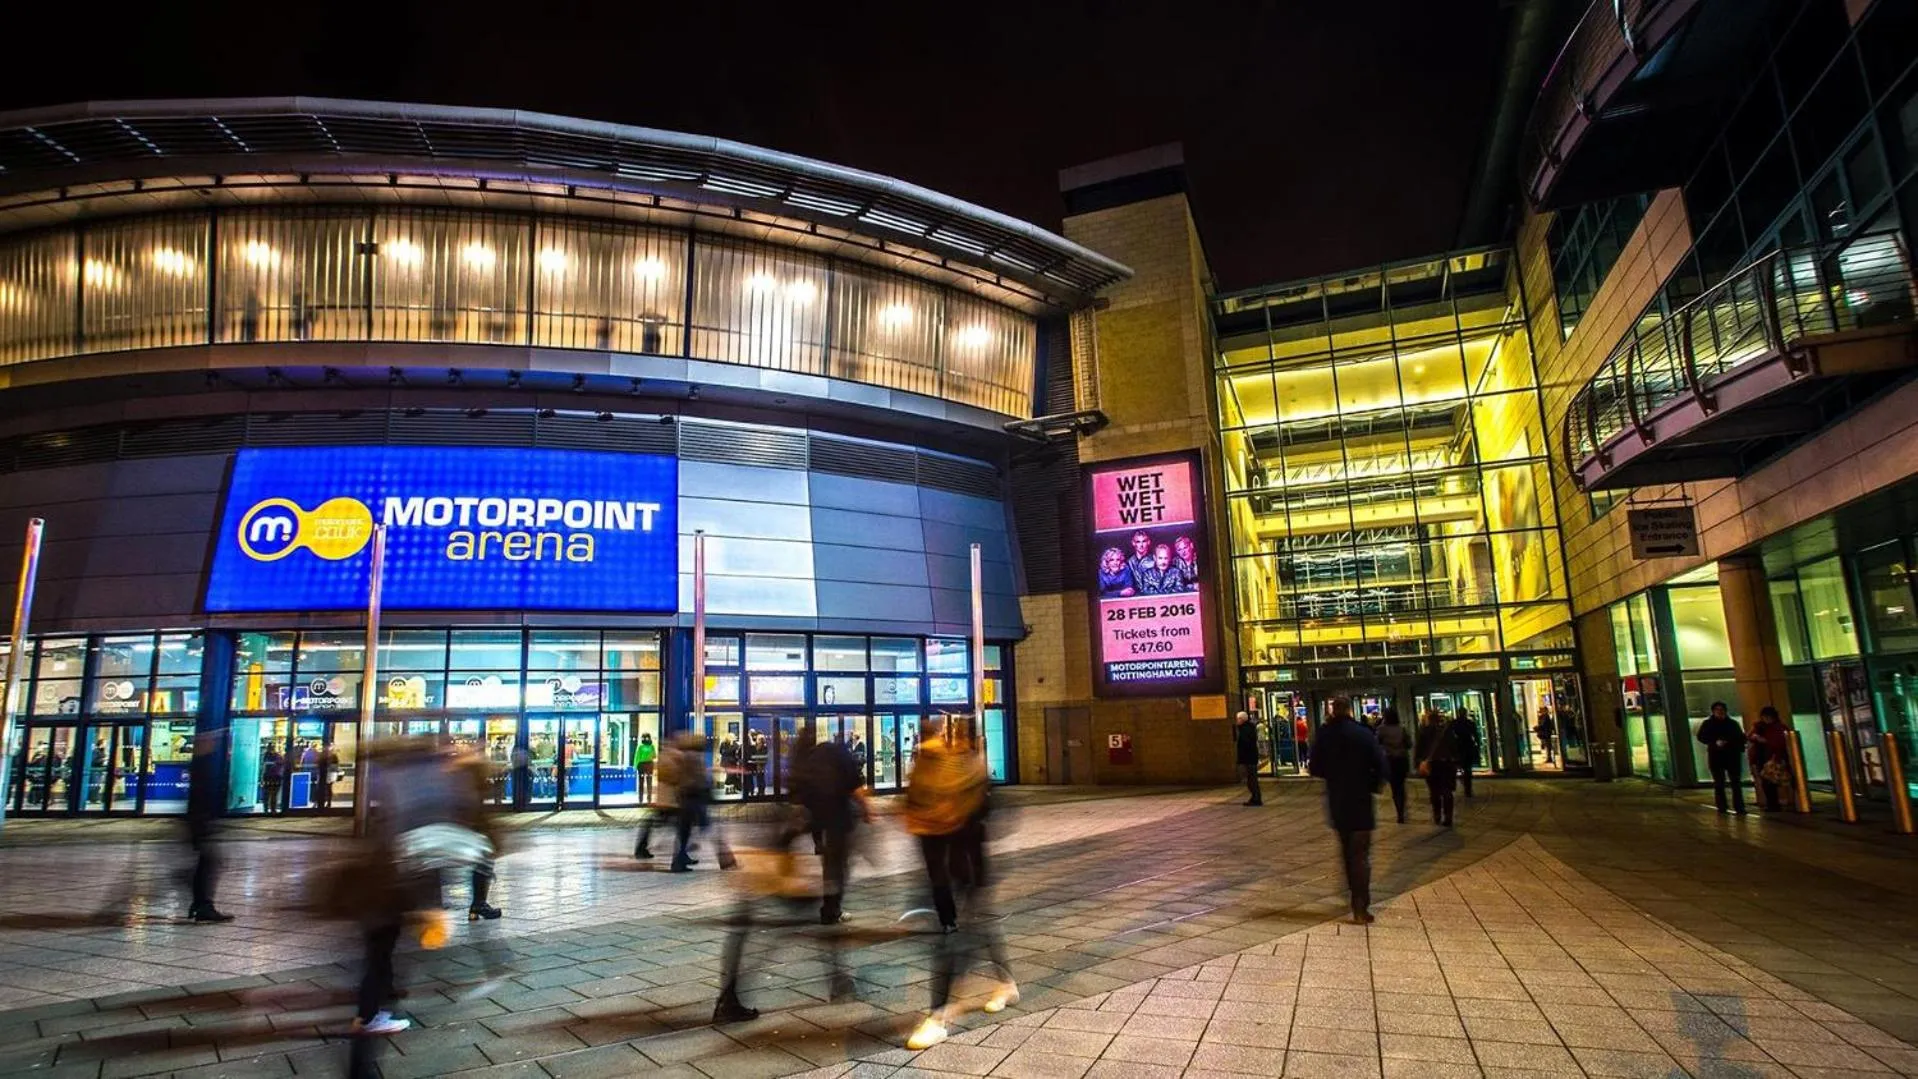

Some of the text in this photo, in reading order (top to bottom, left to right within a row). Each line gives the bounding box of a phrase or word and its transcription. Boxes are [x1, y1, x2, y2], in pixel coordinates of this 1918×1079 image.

[1117, 472, 1163, 491] WET
[1118, 489, 1165, 508] WET
[384, 497, 660, 531] MOTORPOINT
[1119, 506, 1166, 524] WET
[1640, 532, 1688, 541] Entrance
[446, 530, 595, 562] arena
[1107, 604, 1195, 621] 28 FEB 2016
[1113, 626, 1190, 640] Tickets from
[1131, 641, 1173, 654] £47.60
[1110, 660, 1199, 672] MOTORPOINTARENA
[1112, 669, 1198, 681] NOTTINGHAM.COM
[1111, 735, 1120, 747] 5
